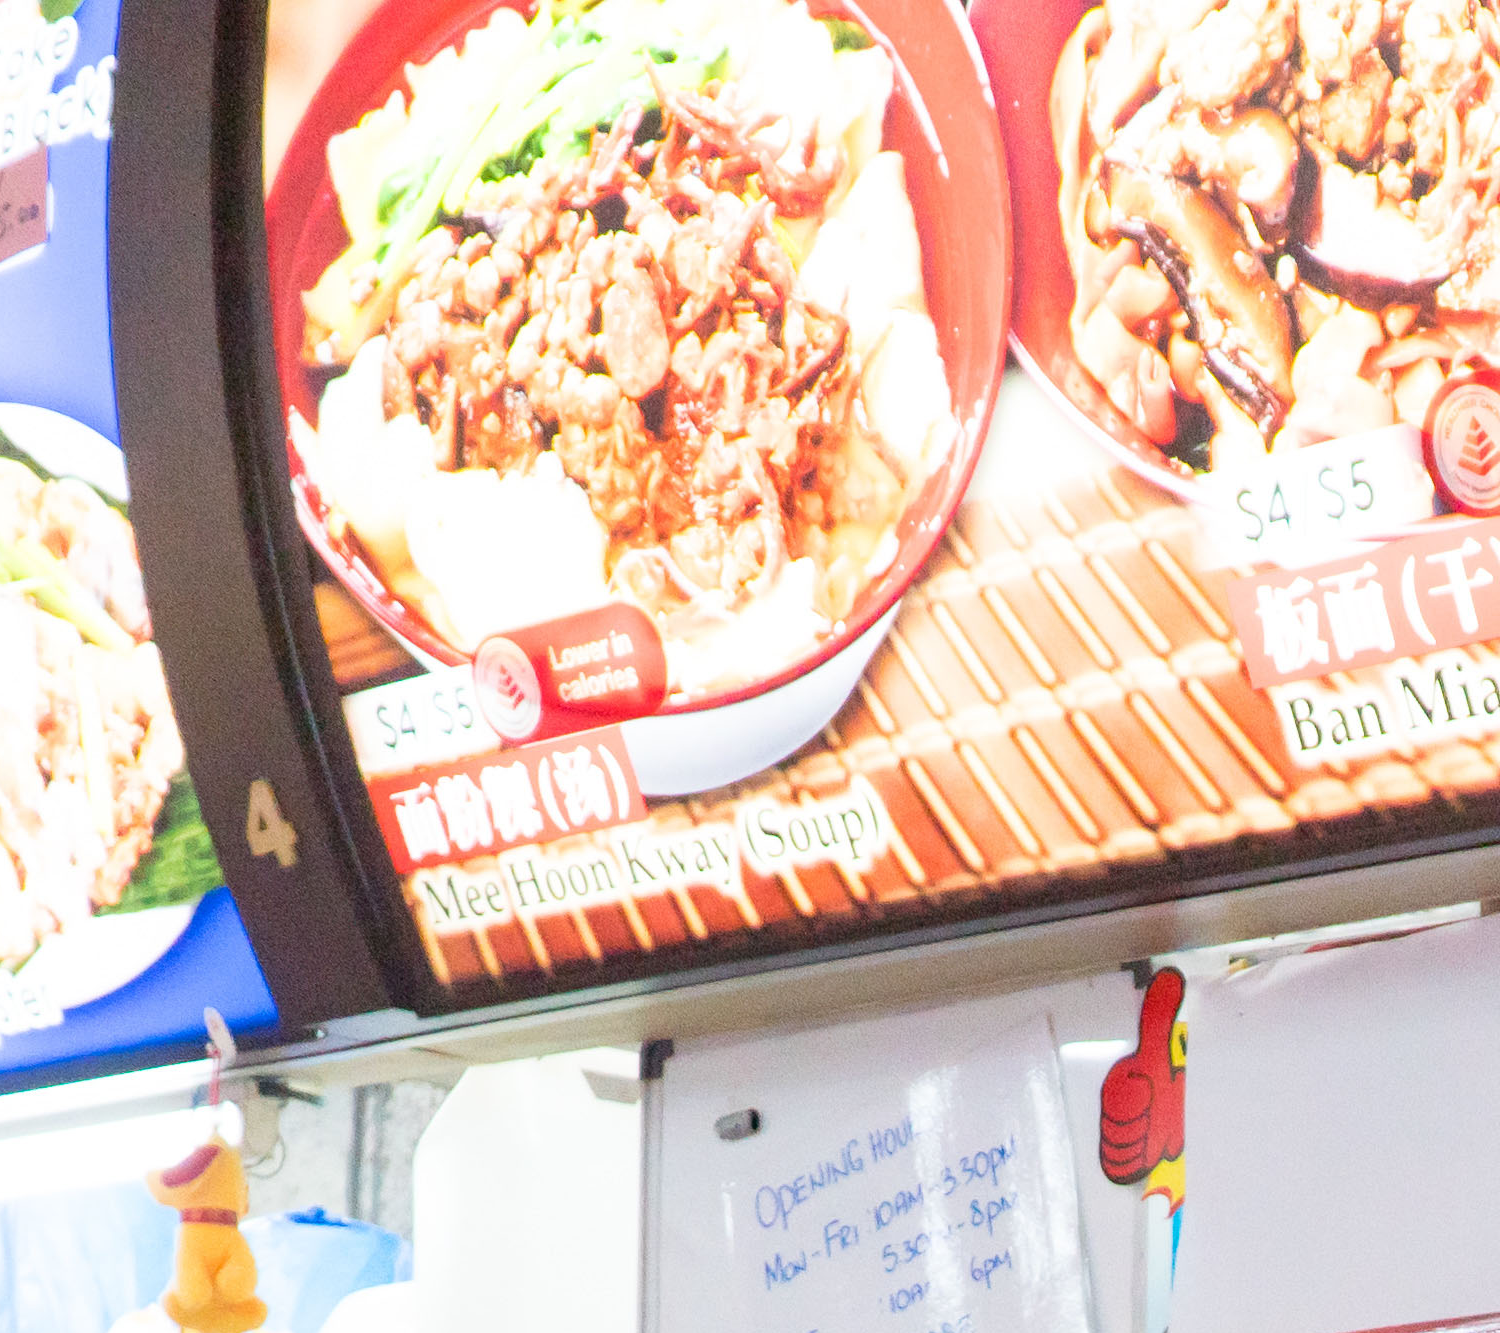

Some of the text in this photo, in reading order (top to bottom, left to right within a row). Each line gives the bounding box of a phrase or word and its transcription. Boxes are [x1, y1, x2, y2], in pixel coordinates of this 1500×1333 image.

[547, 630, 634, 672] Lower in
[557, 661, 639, 702] calories
[1286, 695, 1387, 753] Ban
[246, 779, 298, 868] 4
[423, 776, 886, 925] Mee Hoon Kway (Soup)
[755, 1139, 863, 1231] OPENING
